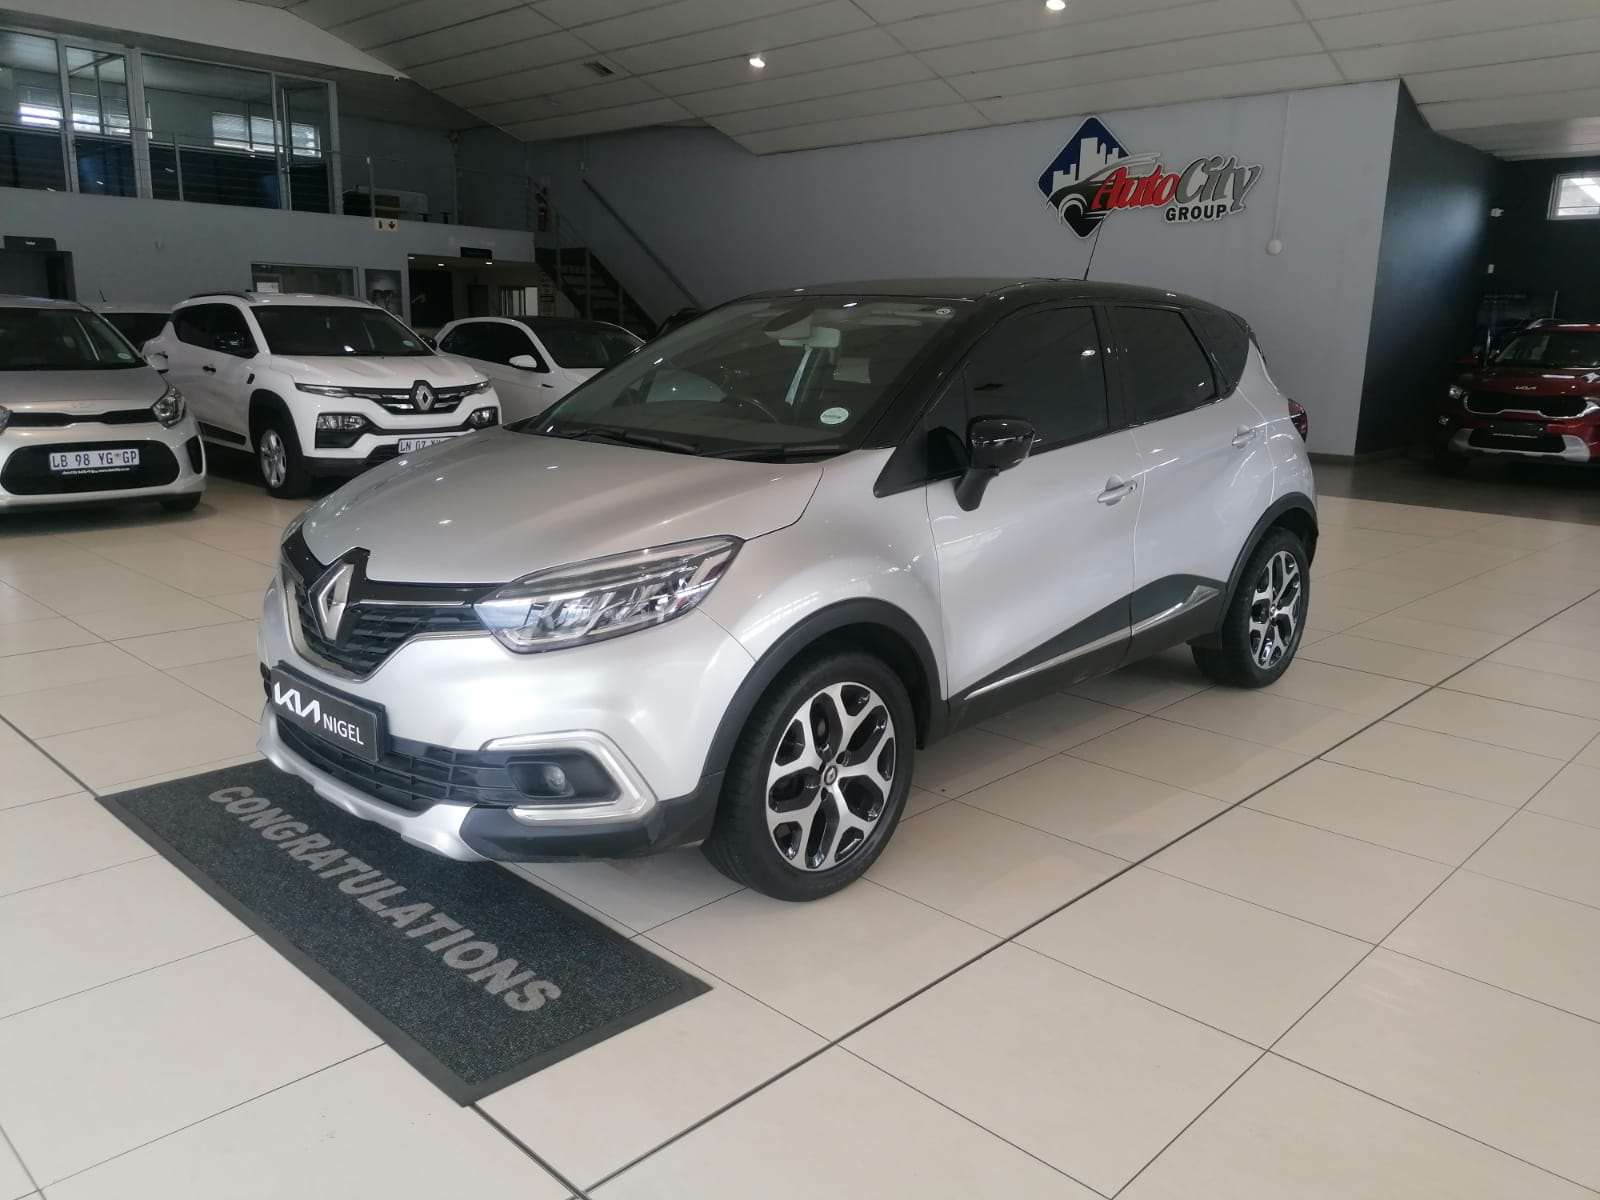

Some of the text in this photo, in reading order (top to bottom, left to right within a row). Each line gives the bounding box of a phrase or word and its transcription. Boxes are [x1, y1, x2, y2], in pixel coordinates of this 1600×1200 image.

[1091, 156, 1261, 212] AutoCity
[1165, 204, 1227, 222] GROUP
[52, 450, 137, 468] LB 98 YG GP
[400, 440, 411, 452] LN
[322, 712, 365, 746] NIGEL
[208, 785, 562, 1012] CONGRATULATIONS
